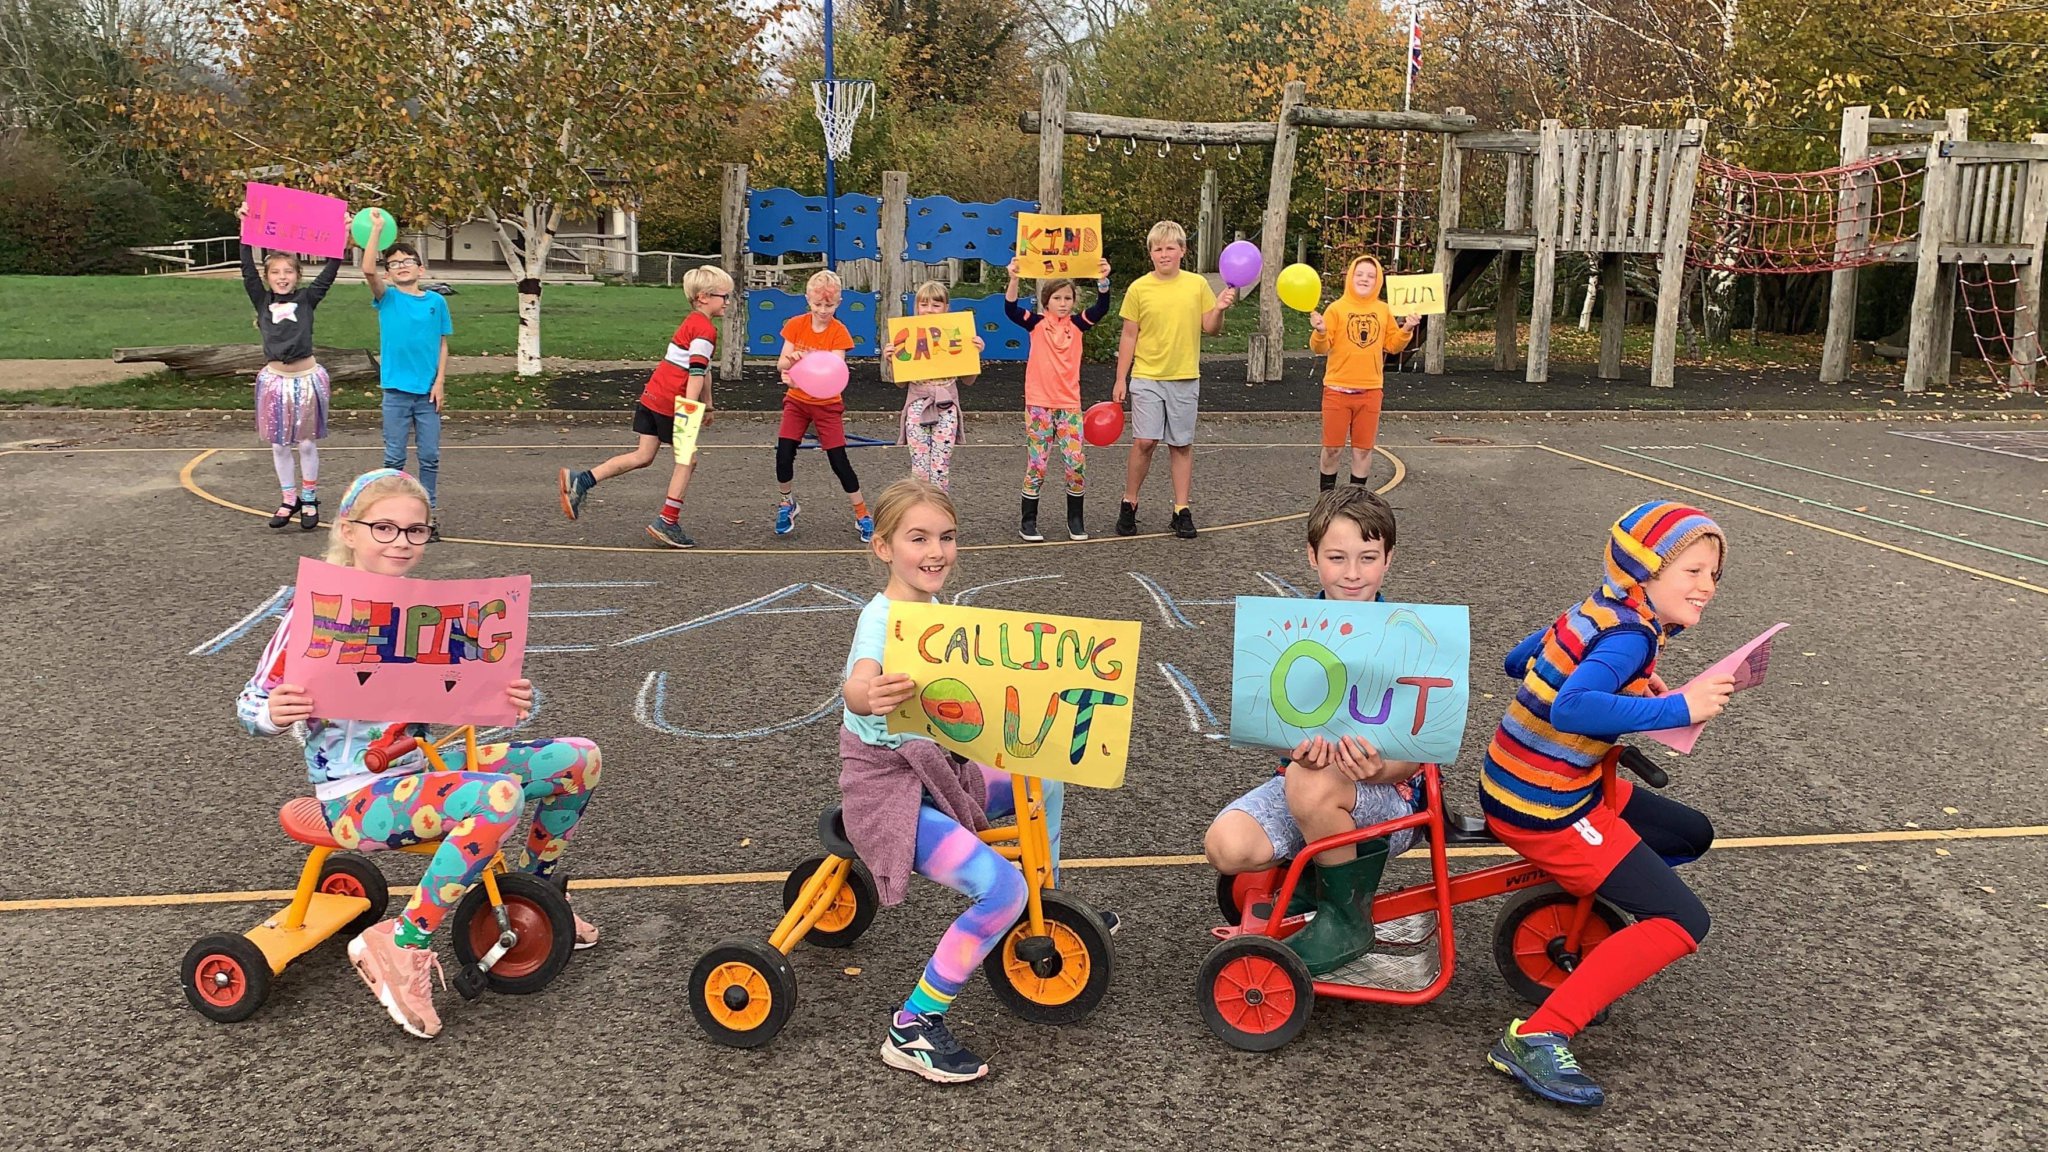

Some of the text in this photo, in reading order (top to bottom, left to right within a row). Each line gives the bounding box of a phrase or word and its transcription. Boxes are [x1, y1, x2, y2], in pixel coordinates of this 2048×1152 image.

[1020, 225, 1098, 256] KIND
[1393, 286, 1435, 306] run
[894, 326, 962, 361] CARE
[302, 592, 512, 664] HELPING
[918, 622, 1122, 680] CALLING
[1270, 639, 1453, 736] OUT
[920, 678, 1129, 765] OUT
